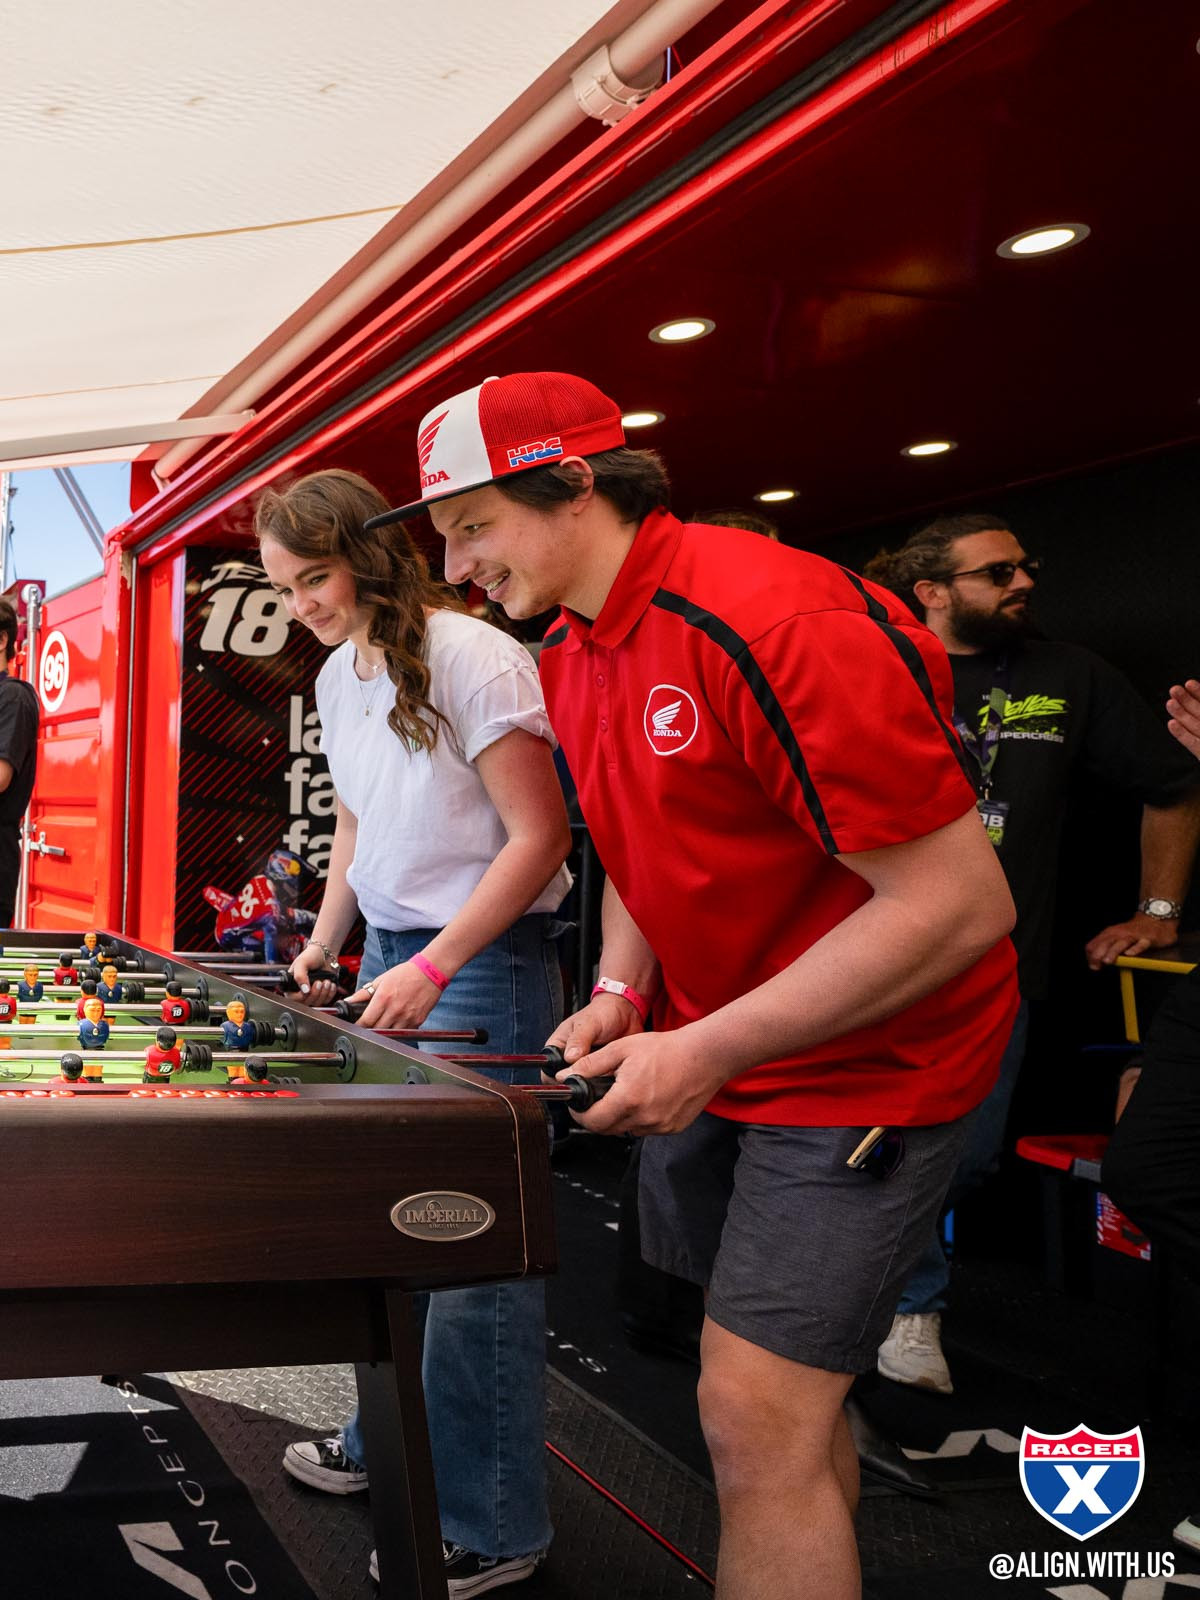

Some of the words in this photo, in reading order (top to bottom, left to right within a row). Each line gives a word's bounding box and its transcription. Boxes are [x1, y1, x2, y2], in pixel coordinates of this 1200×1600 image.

[507, 436, 563, 468] HRC
[200, 587, 290, 656] 18
[44, 650, 65, 692] 96
[172, 1008, 183, 1017] 18
[160, 1064, 172, 1073] 18
[405, 1208, 482, 1223] IMPERIAL
